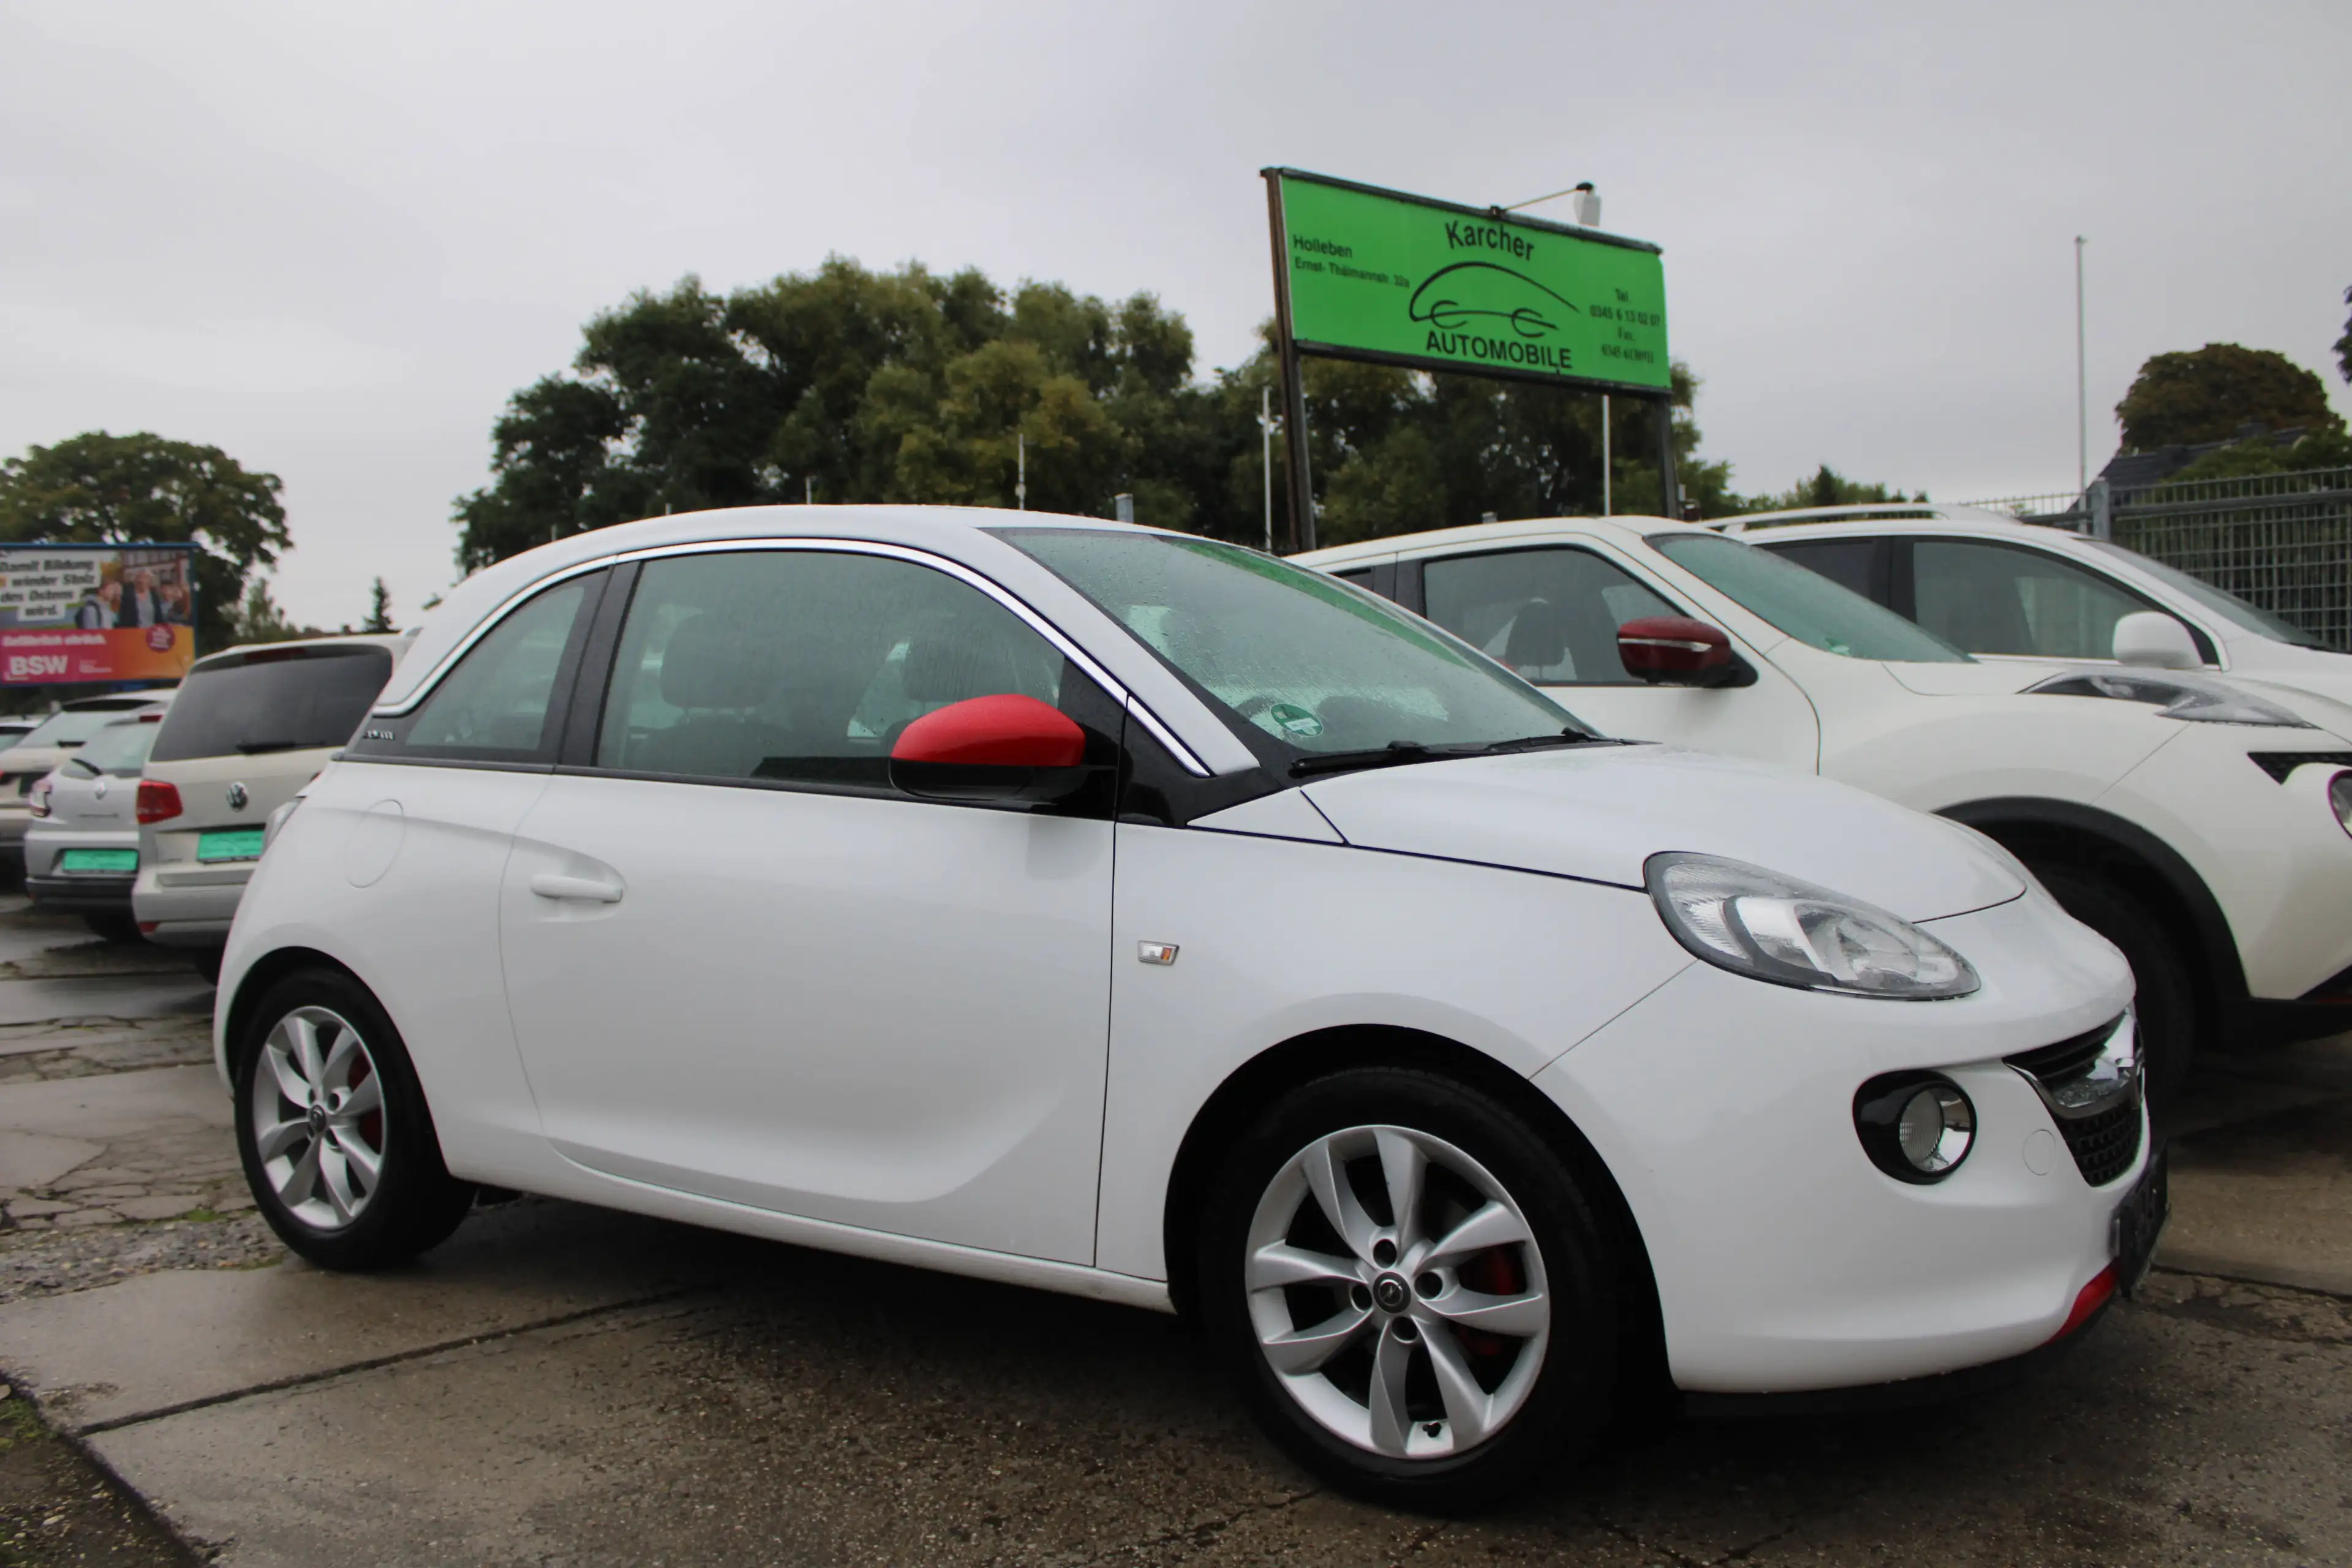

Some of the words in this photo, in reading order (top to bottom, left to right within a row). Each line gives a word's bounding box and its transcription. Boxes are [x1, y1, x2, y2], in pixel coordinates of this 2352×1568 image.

[1293, 234, 1353, 258] Holleben
[1446, 219, 1534, 262] Karcher
[1426, 330, 1574, 369] AUTOMOBILE
[9, 655, 69, 676] BSW
